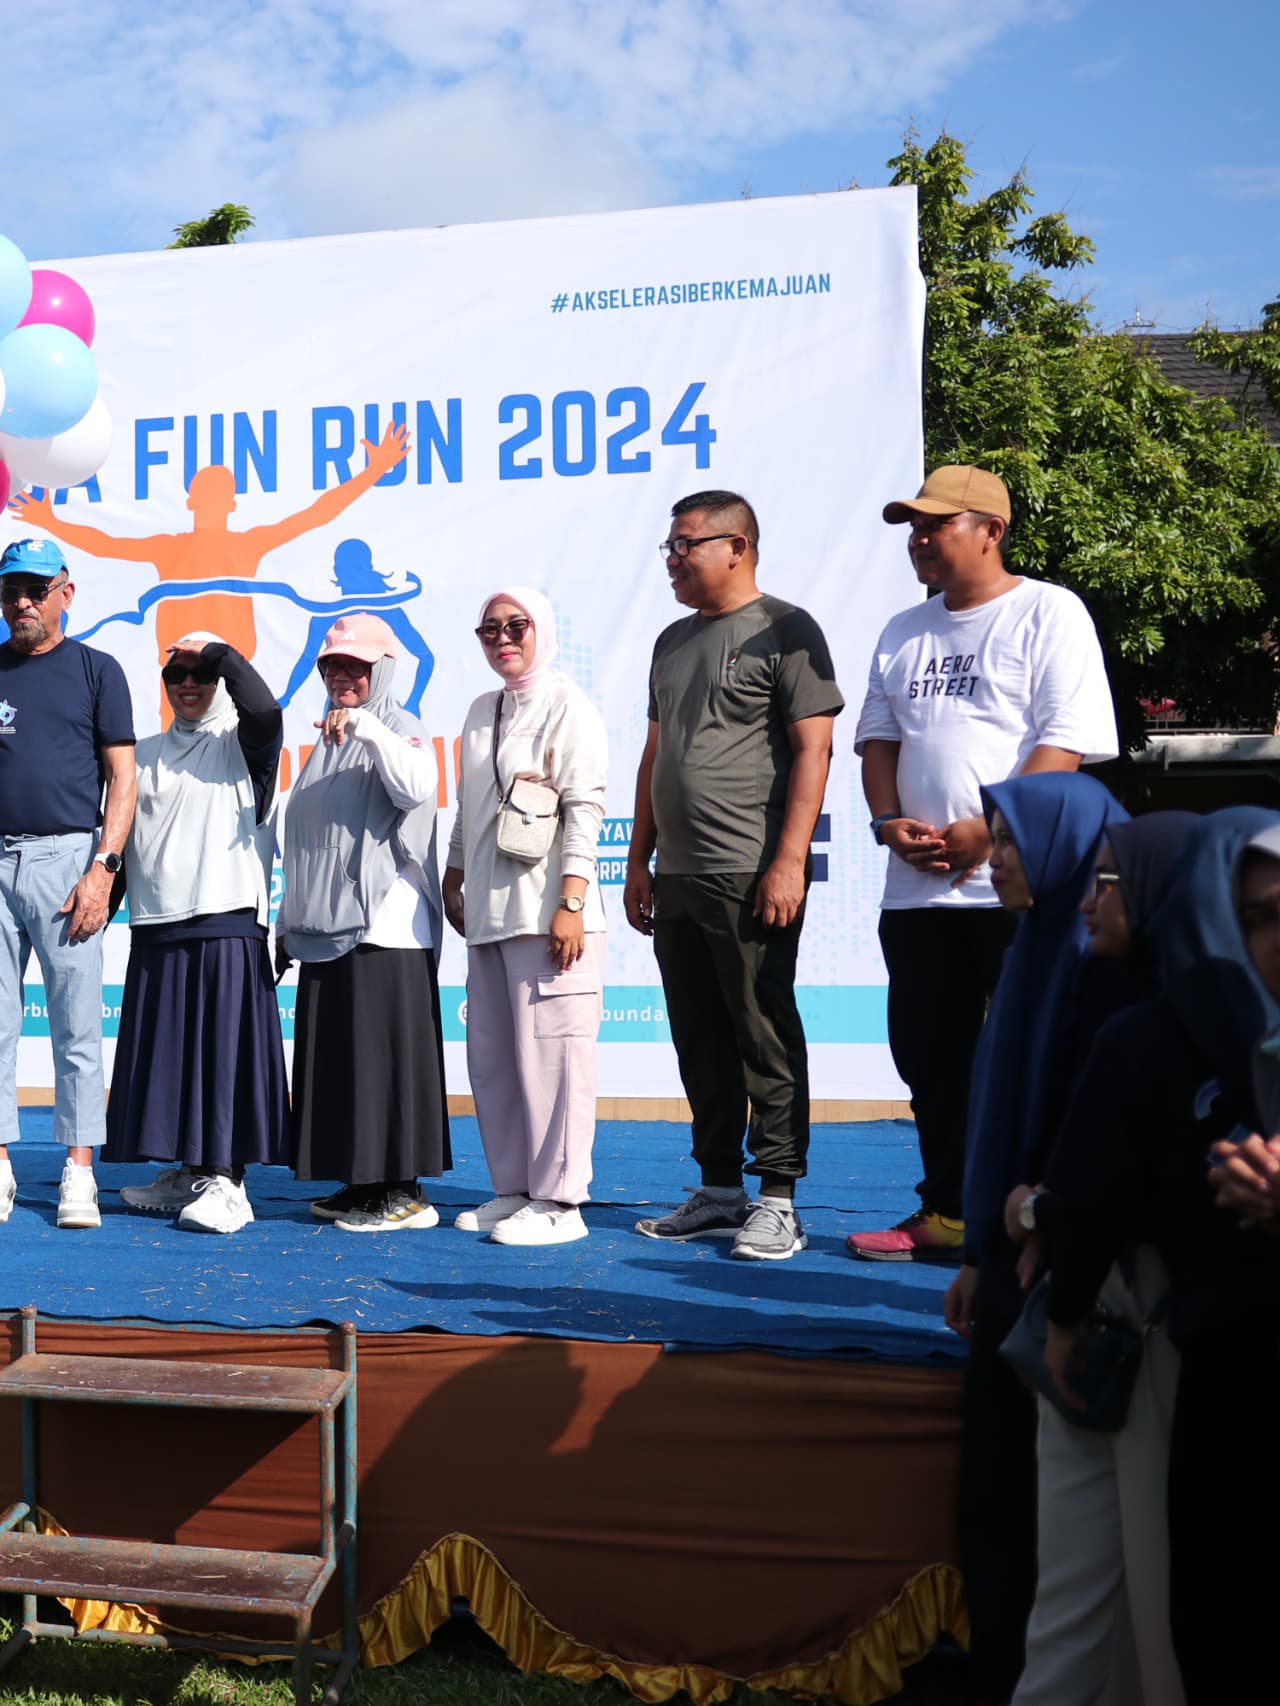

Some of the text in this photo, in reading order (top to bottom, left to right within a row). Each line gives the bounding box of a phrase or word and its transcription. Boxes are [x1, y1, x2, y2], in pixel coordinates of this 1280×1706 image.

[550, 273, 831, 313] #AKSELERASIBERKEMAJUAN
[134, 382, 716, 500] FUN RUN 2024
[925, 654, 975, 675] AERO
[909, 677, 978, 699] STREET
